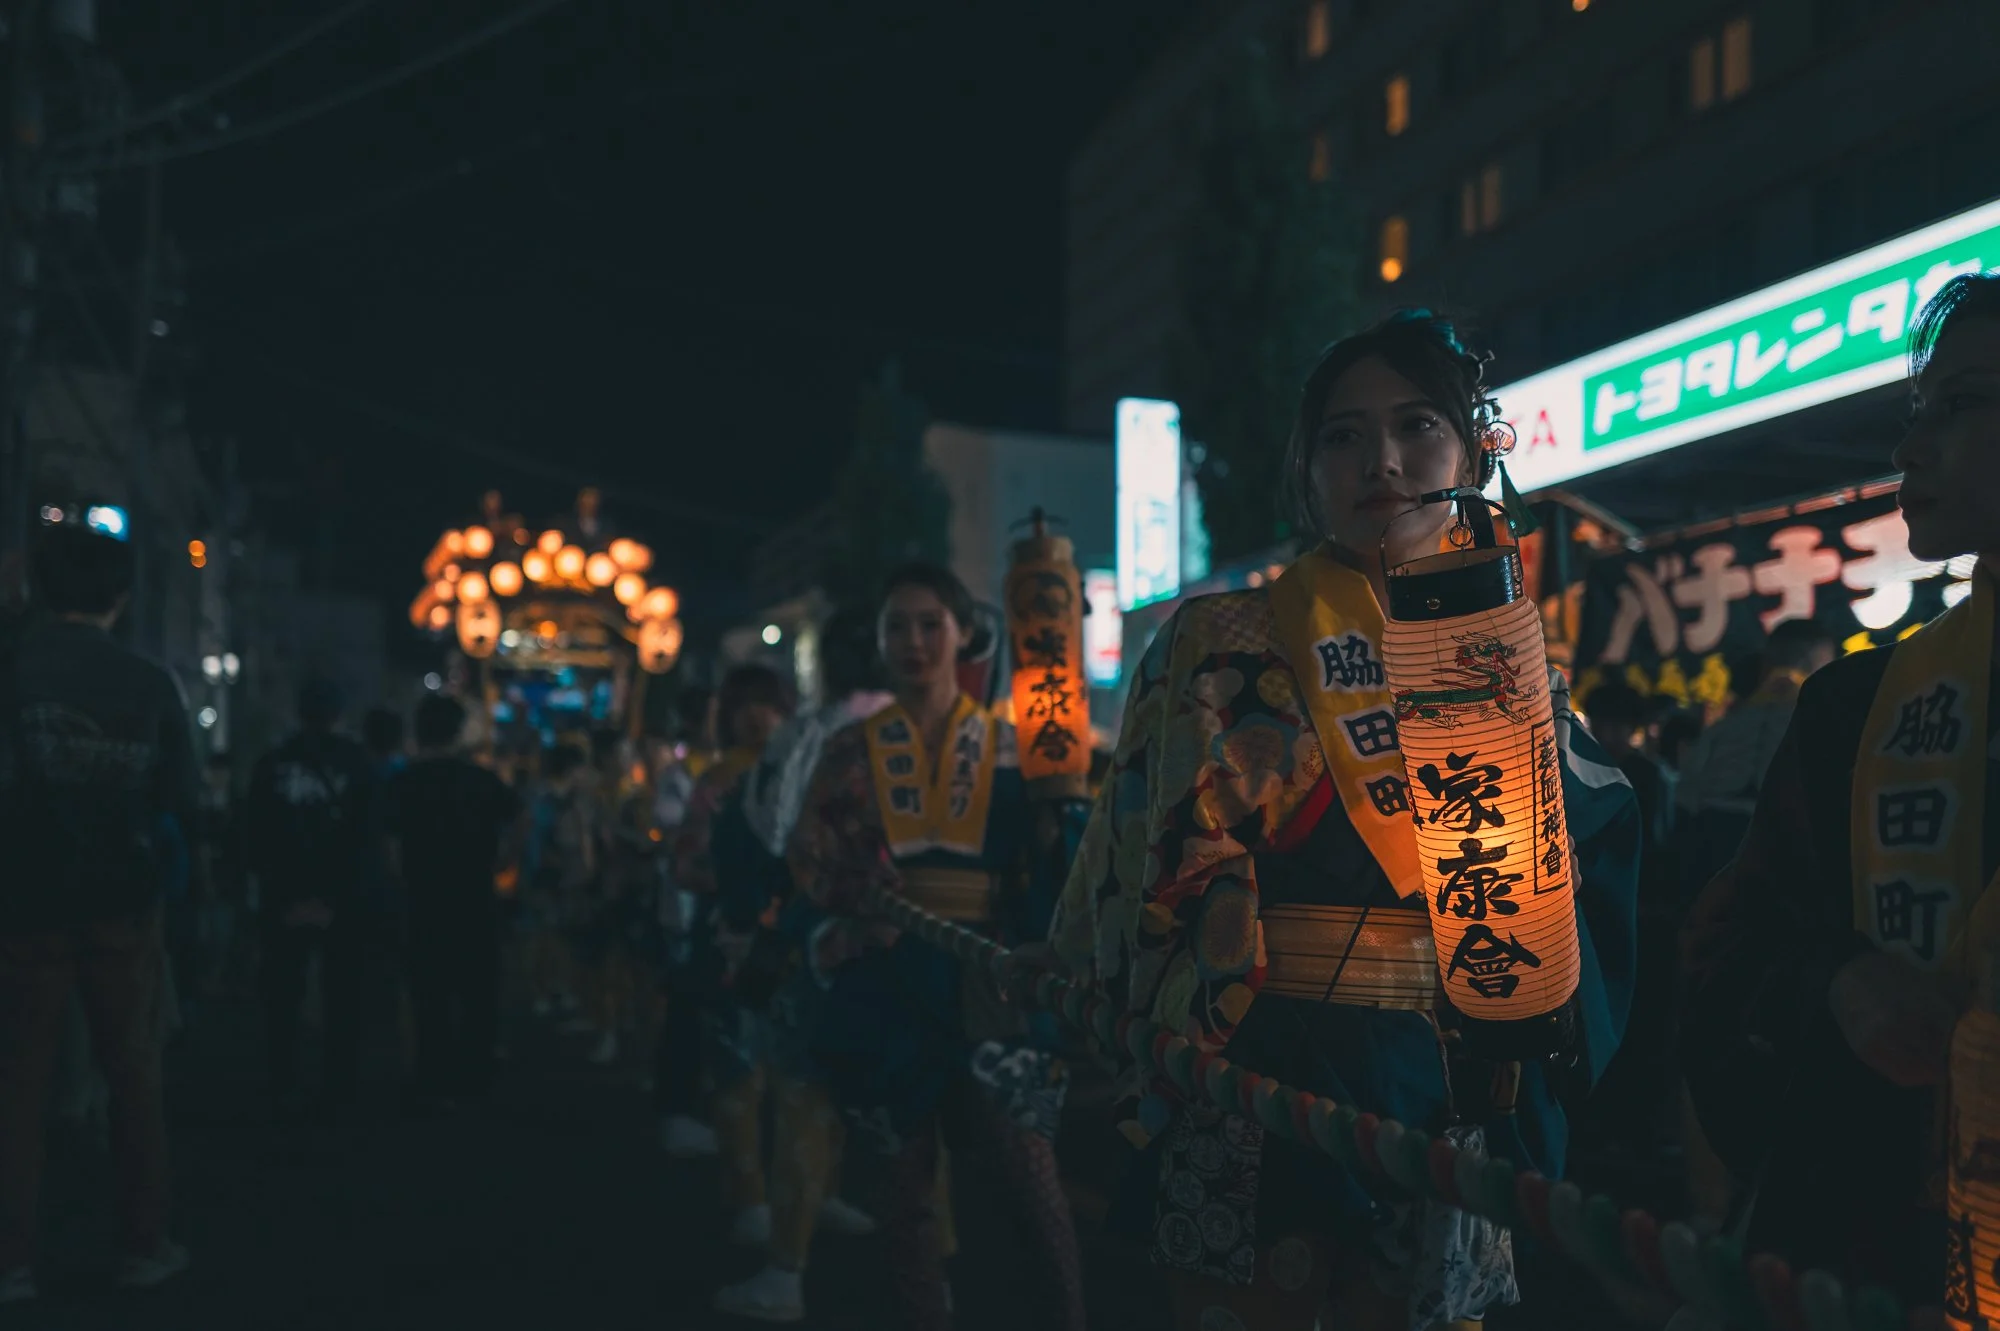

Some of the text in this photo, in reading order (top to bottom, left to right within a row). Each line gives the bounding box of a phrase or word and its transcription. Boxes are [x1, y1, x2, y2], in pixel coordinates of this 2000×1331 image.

[1416, 752, 1541, 998] 家康會
[1875, 684, 1961, 961] 脇田町
